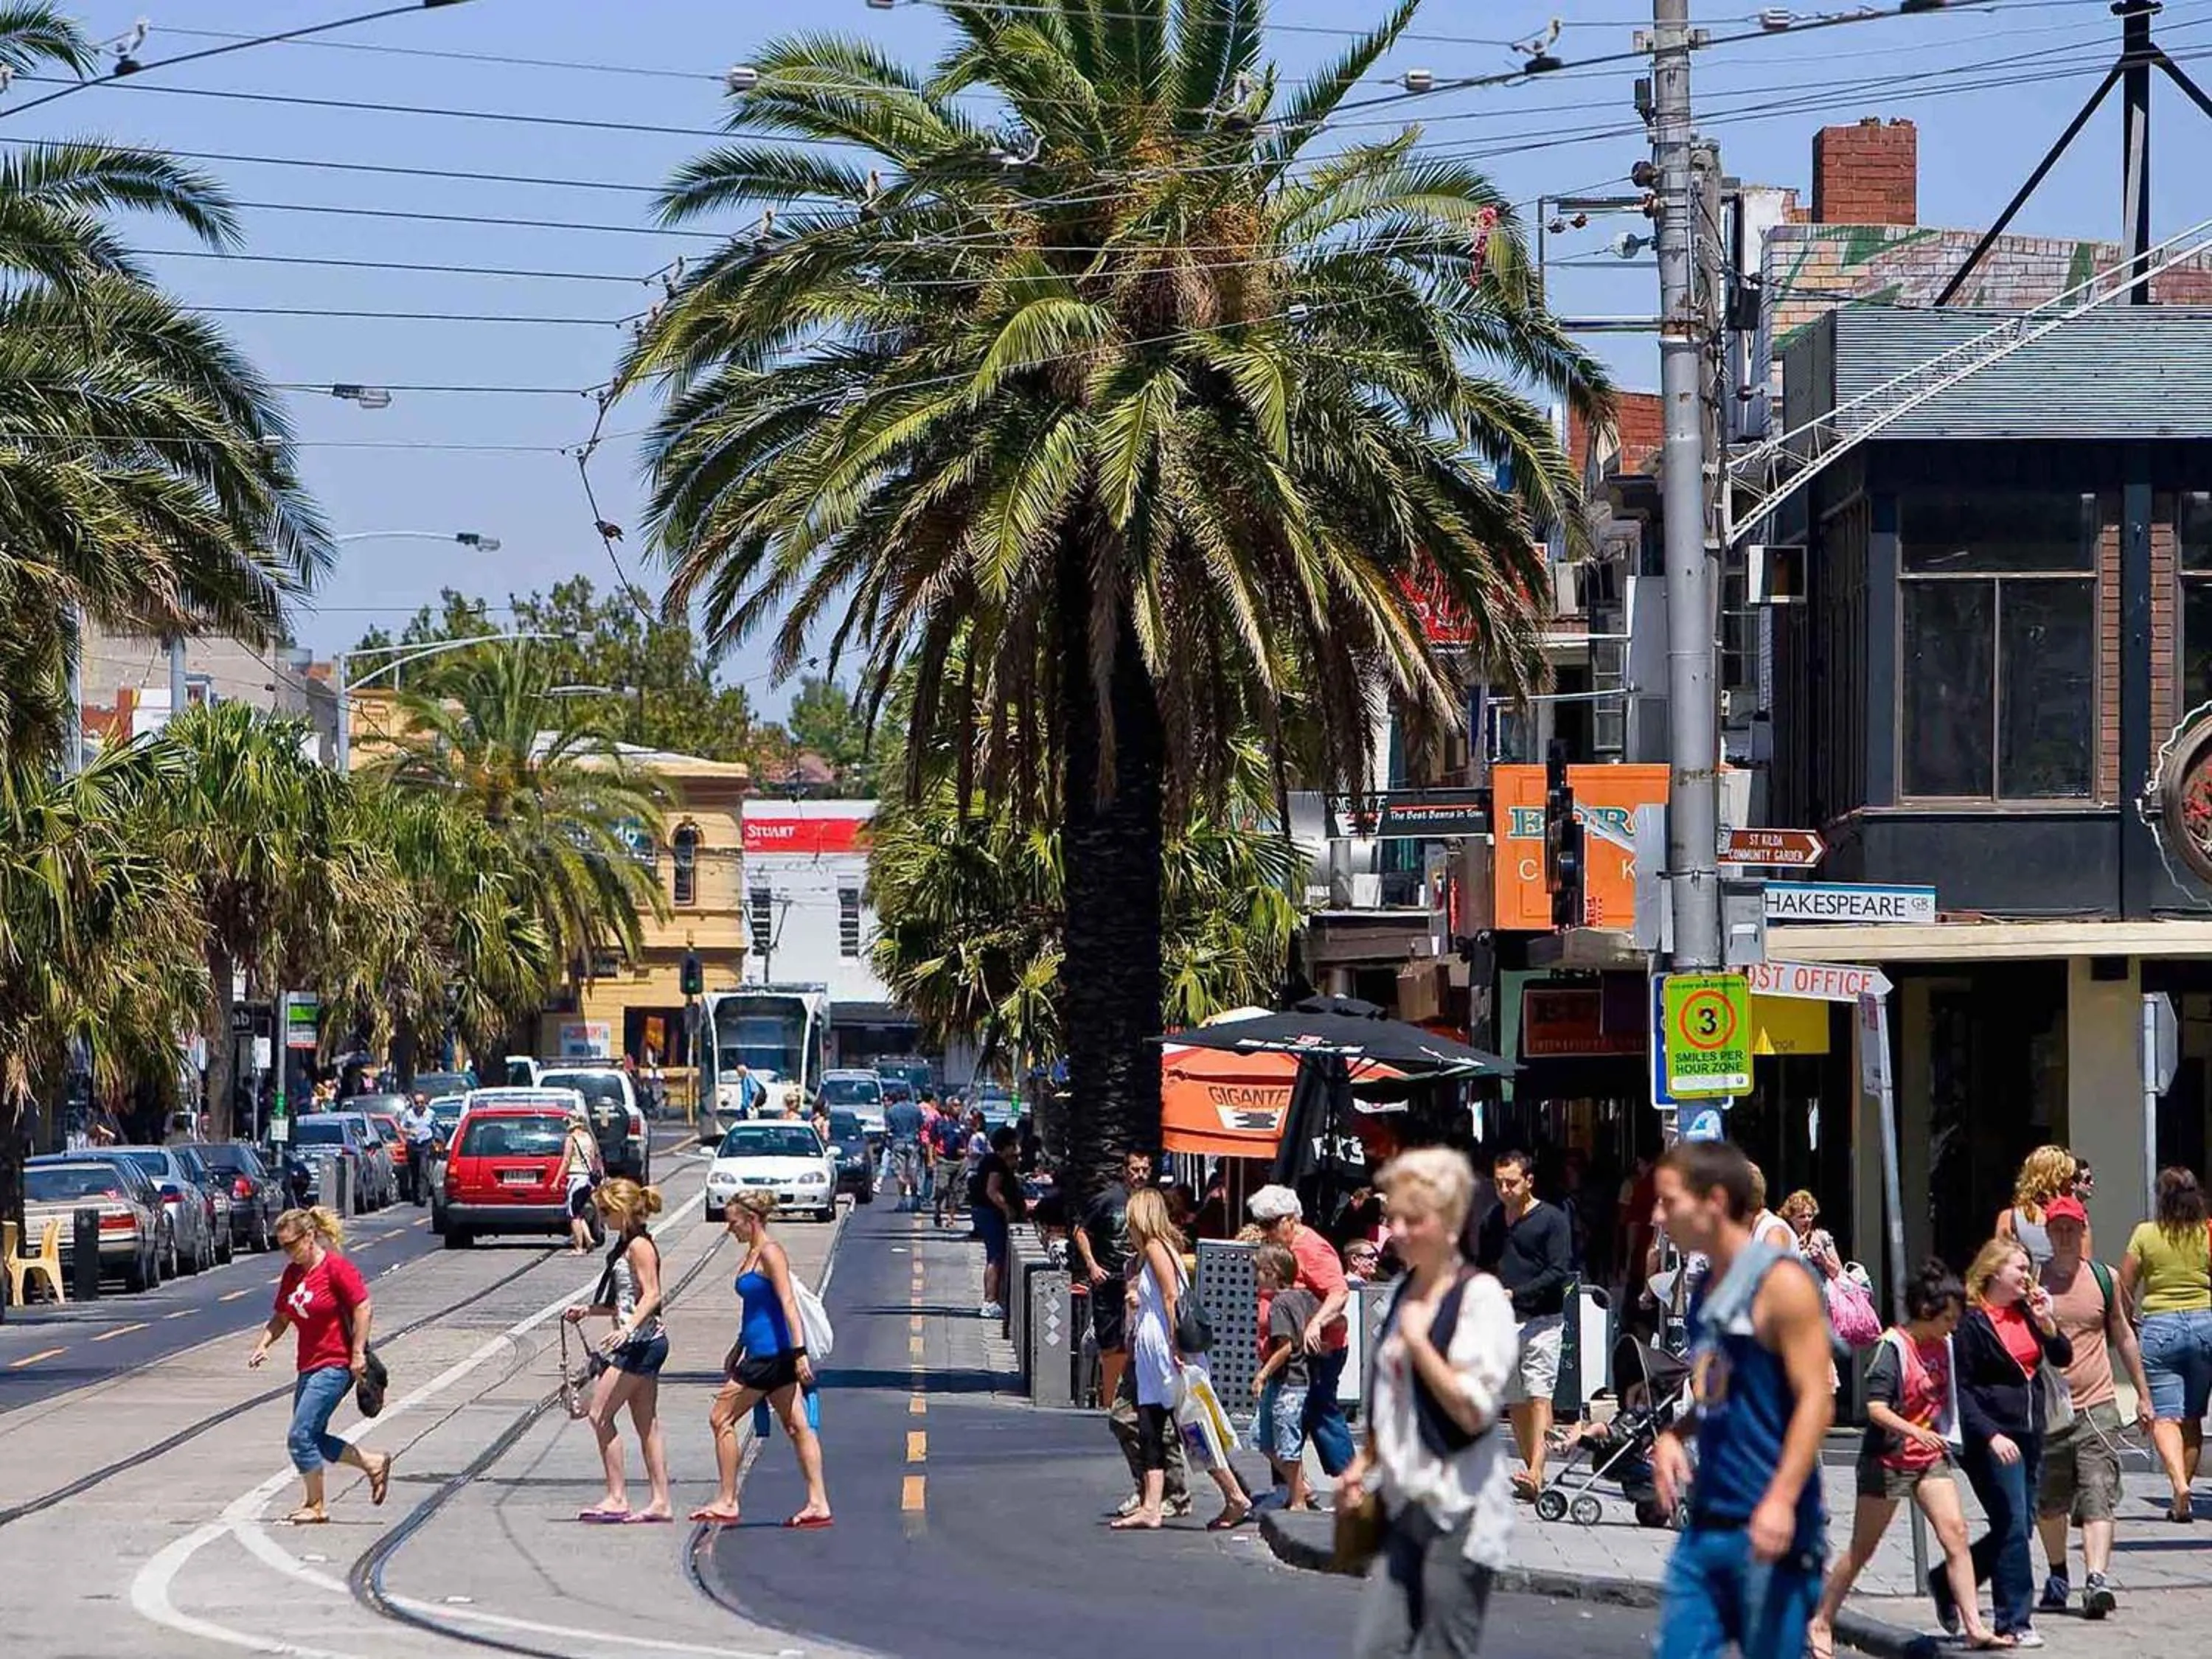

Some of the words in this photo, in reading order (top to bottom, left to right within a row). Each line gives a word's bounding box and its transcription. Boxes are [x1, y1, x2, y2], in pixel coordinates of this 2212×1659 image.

[1749, 834, 1759, 846] ST
[1762, 835, 1784, 846] KILDA
[1728, 849, 1770, 861] COMMUNITY
[1774, 849, 1804, 862] GARDEN
[1764, 893, 1906, 917] HAKESPEARE
[1795, 967, 1873, 995] OFFICE
[1698, 1008, 1717, 1036] 3
[1675, 1051, 1717, 1062] SMILES
[1720, 1049, 1744, 1060] PER
[1676, 1063, 1710, 1074] HOUR
[1712, 1062, 1743, 1073] ZONE
[1208, 1086, 1290, 1106] GIGANTE
